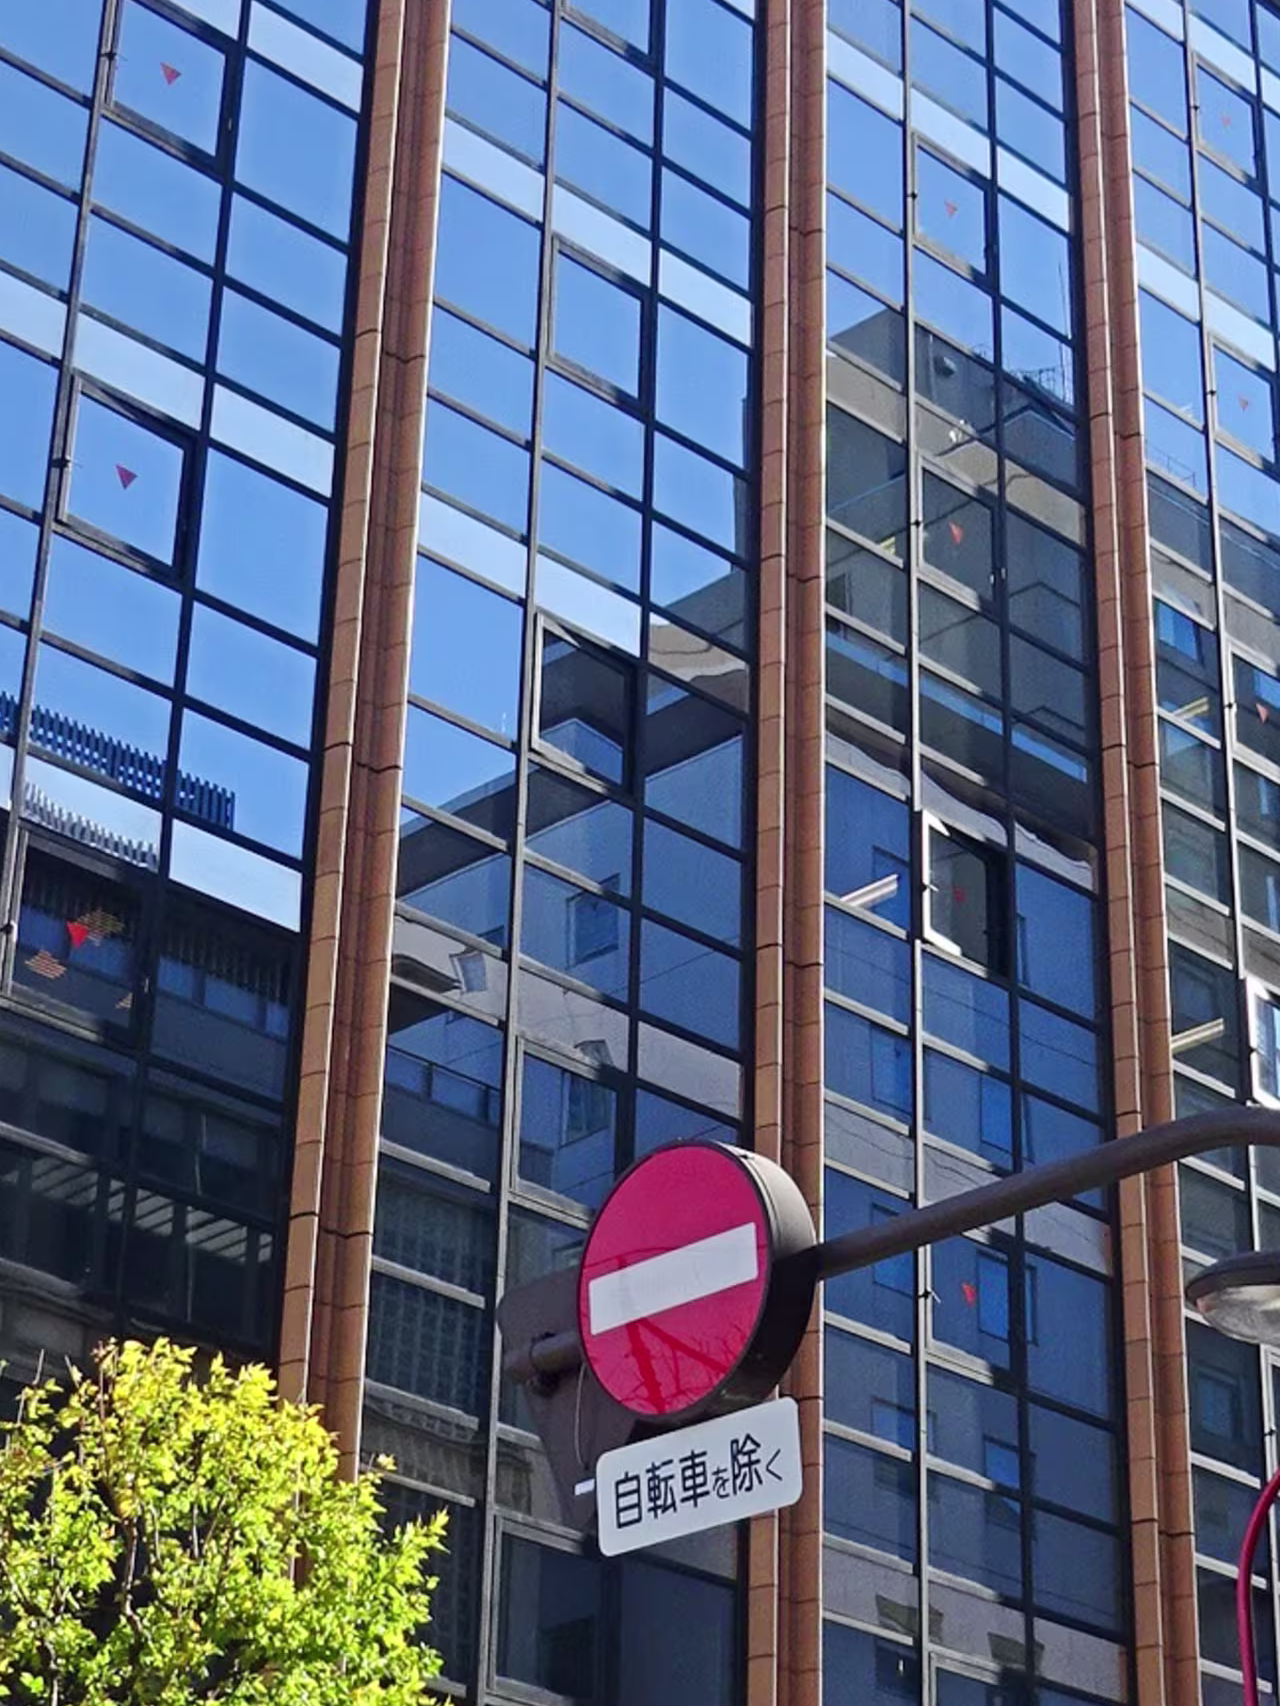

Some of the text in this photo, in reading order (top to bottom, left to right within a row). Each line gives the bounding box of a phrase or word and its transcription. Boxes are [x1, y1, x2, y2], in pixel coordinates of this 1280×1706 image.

[615, 1433, 783, 1529] 自転車を除く
